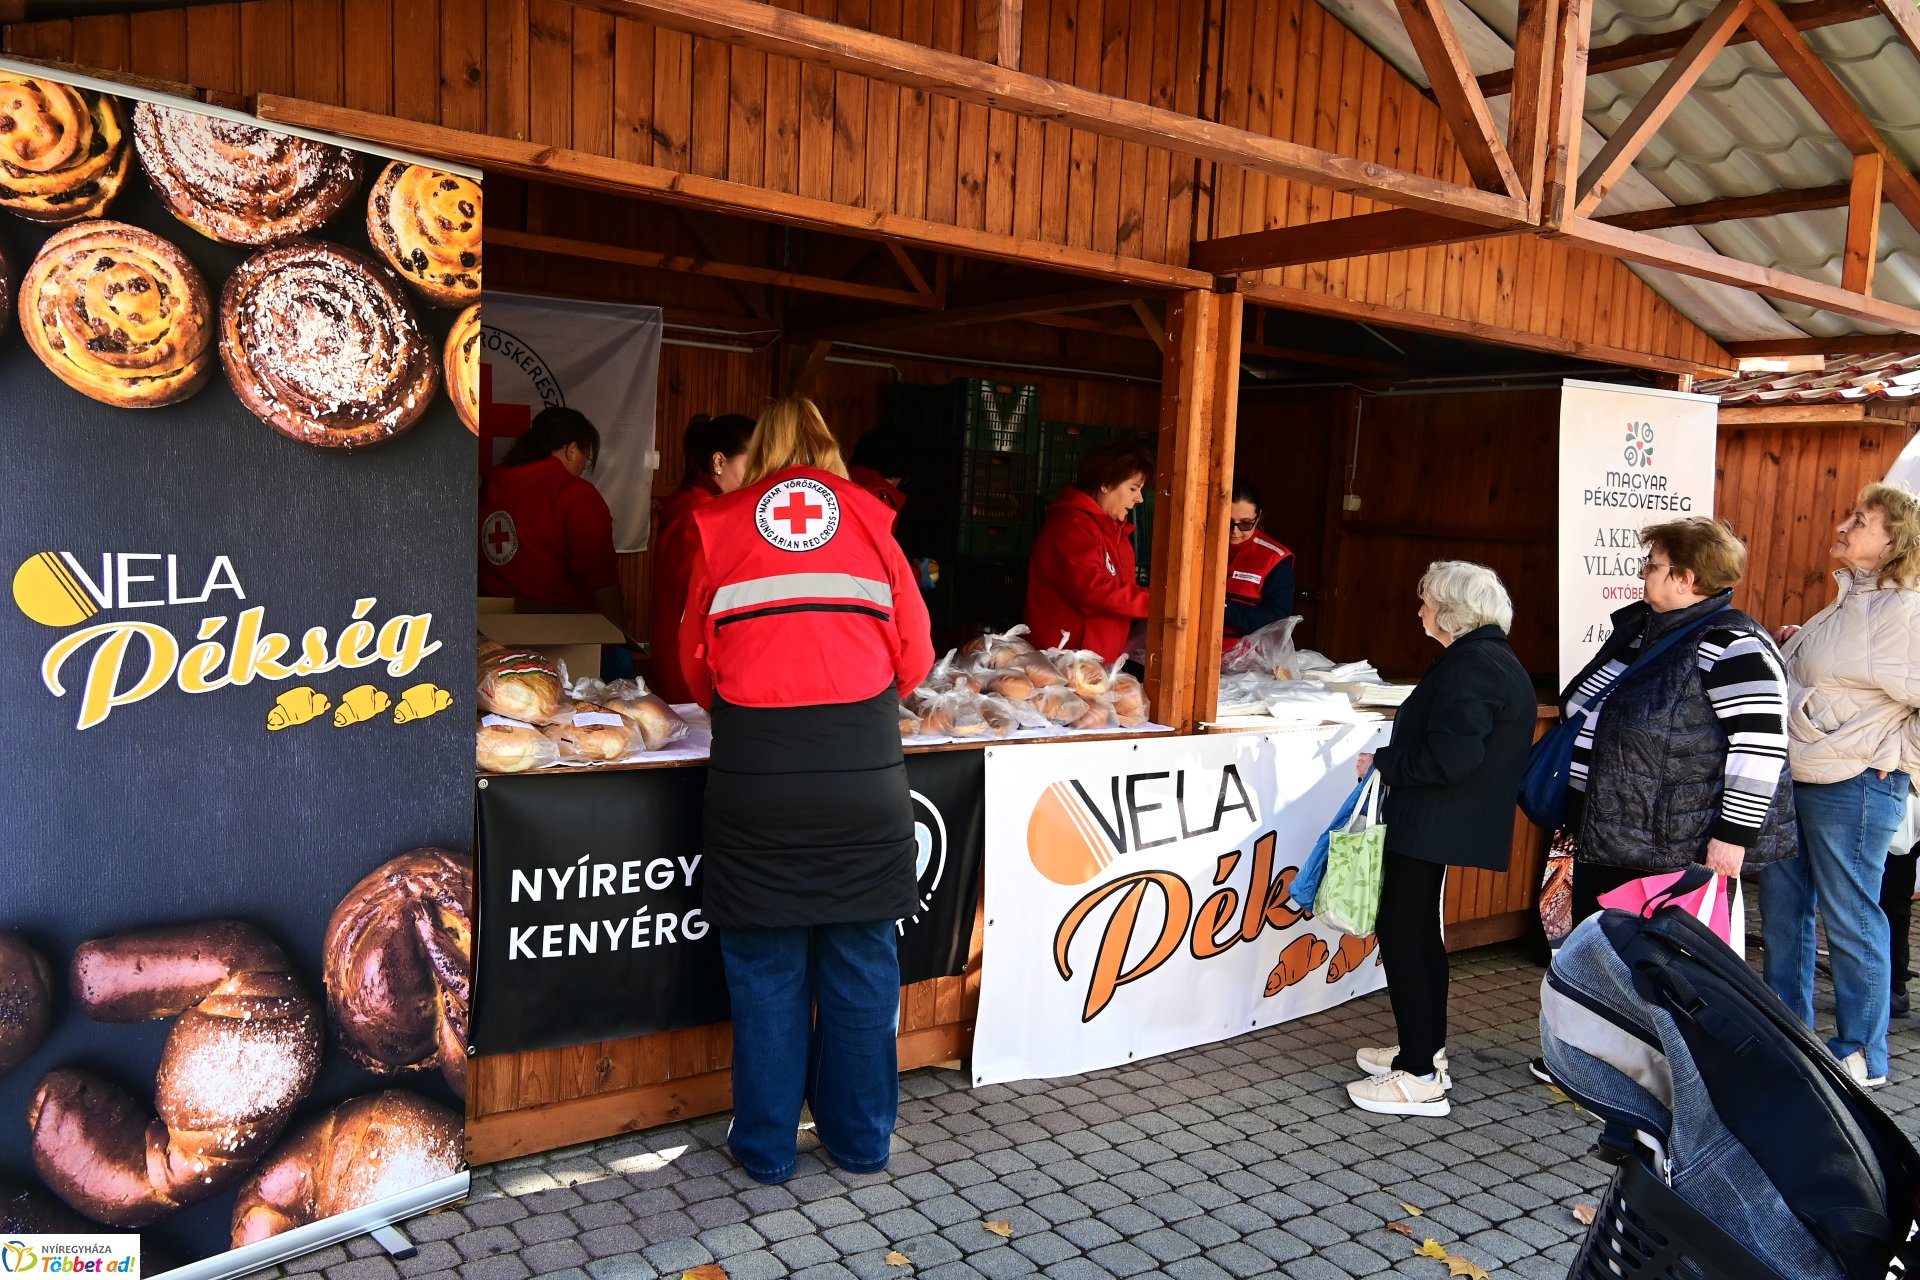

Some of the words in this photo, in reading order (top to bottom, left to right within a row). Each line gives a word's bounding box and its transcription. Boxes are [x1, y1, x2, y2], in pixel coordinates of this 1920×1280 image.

[758, 487, 782, 513] MAGYAR
[783, 479, 837, 512] VÖRÖSKERESZT
[1584, 486, 1691, 512] PÉKSZÖVETSÉG
[1606, 471, 1667, 491] MAGYAR
[758, 517, 800, 549] HUNGARIAN
[802, 536, 821, 549] RED
[819, 515, 837, 541] CROSS
[1594, 527, 1606, 547] A
[1609, 528, 1646, 549] KEN
[60, 551, 246, 609] VELA
[1582, 624, 1594, 643] A
[42, 597, 442, 730] Pékség
[1069, 763, 1257, 855] VELA
[510, 854, 702, 903] NYÍREGY
[508, 904, 710, 960] KENYÉRG
[1053, 829, 1314, 1023] Pék
